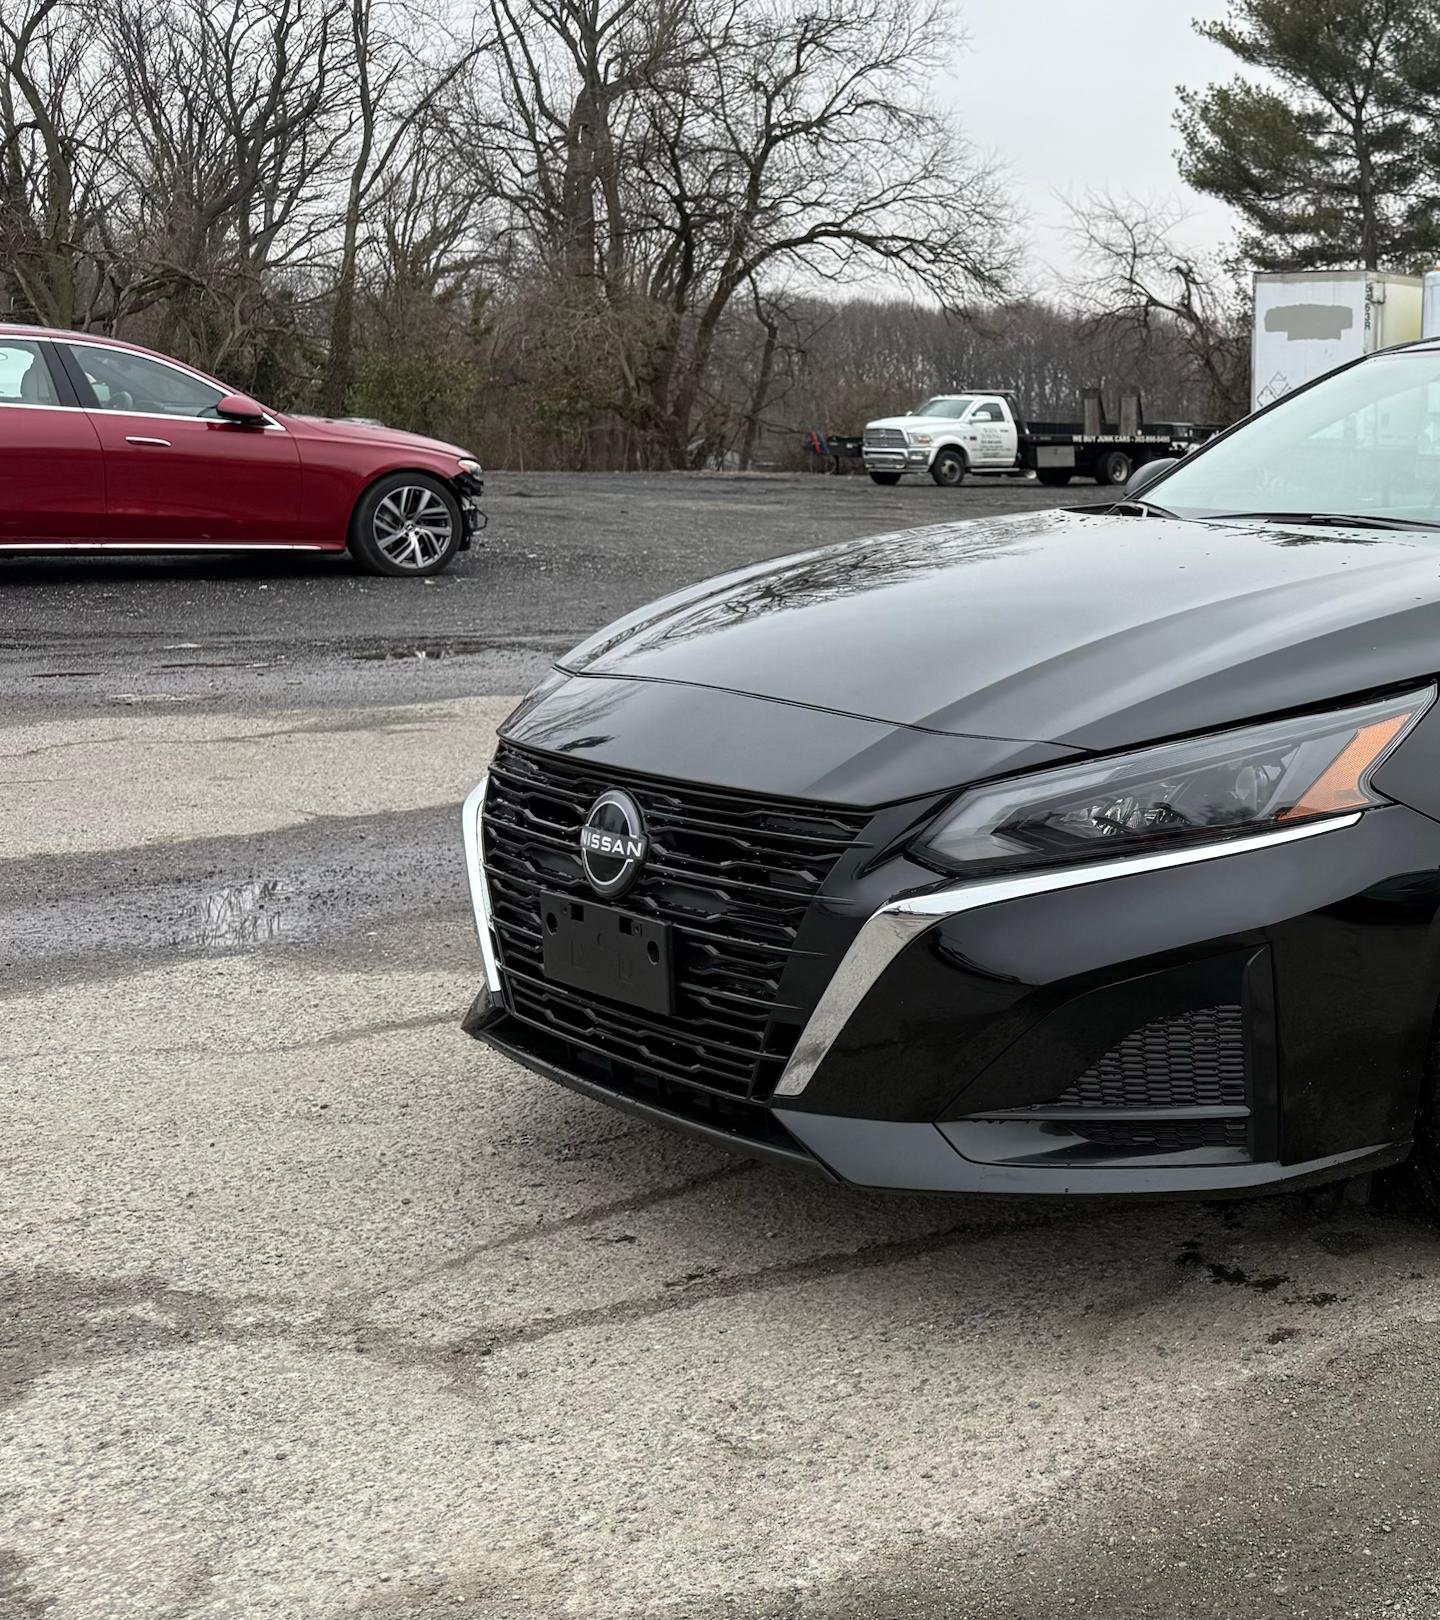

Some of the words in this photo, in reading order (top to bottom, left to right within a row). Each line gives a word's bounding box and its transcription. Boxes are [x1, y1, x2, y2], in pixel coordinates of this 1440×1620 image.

[1072, 435, 1082, 443] WE
[1083, 435, 1096, 443] BUY
[1097, 435, 1113, 443] JUNK
[1114, 435, 1130, 443] CARS
[580, 828, 643, 857] NISSAN
